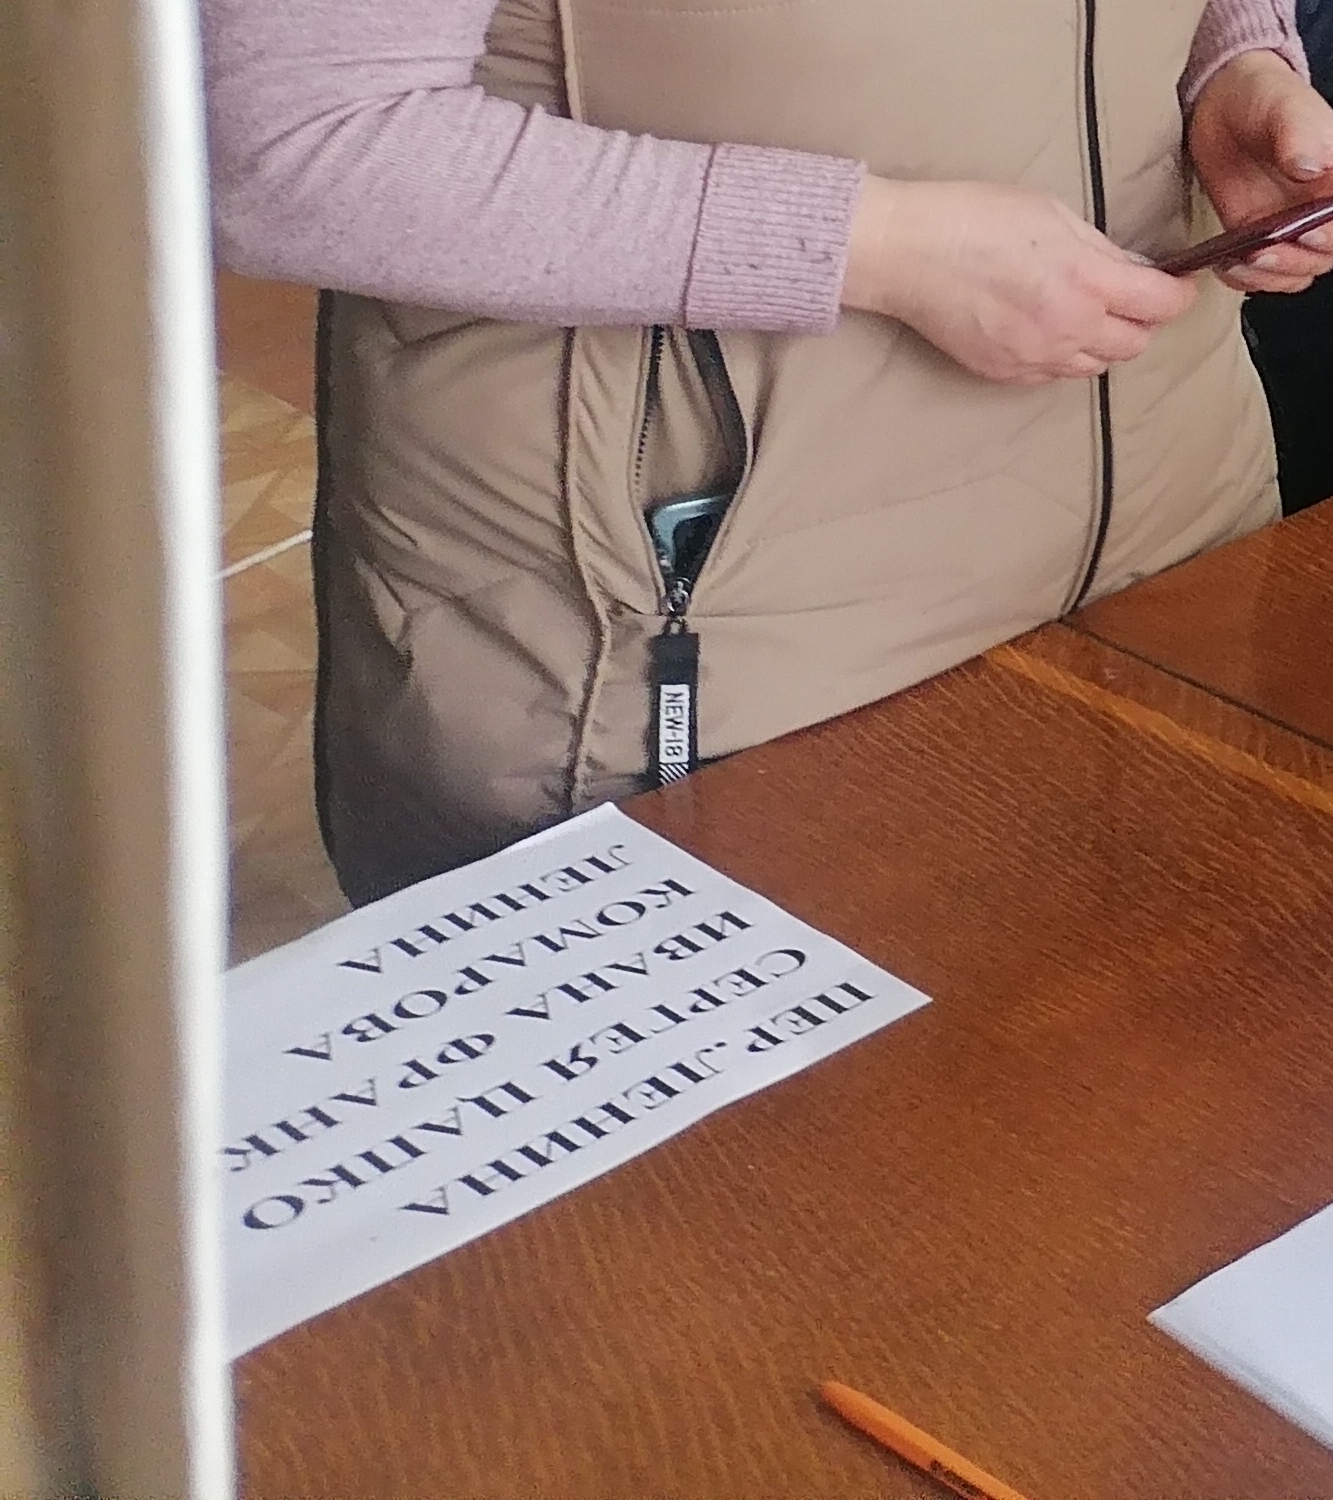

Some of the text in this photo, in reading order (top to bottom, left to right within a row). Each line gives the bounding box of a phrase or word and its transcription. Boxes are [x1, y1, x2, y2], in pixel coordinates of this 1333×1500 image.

[664, 690, 685, 758] NEW-18
[283, 876, 698, 1063] КОМАРОВА
[336, 843, 635, 976] ЛЕНИНА
[506, 908, 758, 1023] ИВАНА
[242, 946, 808, 1231] СЕРГЕЯ ЦАПКО
